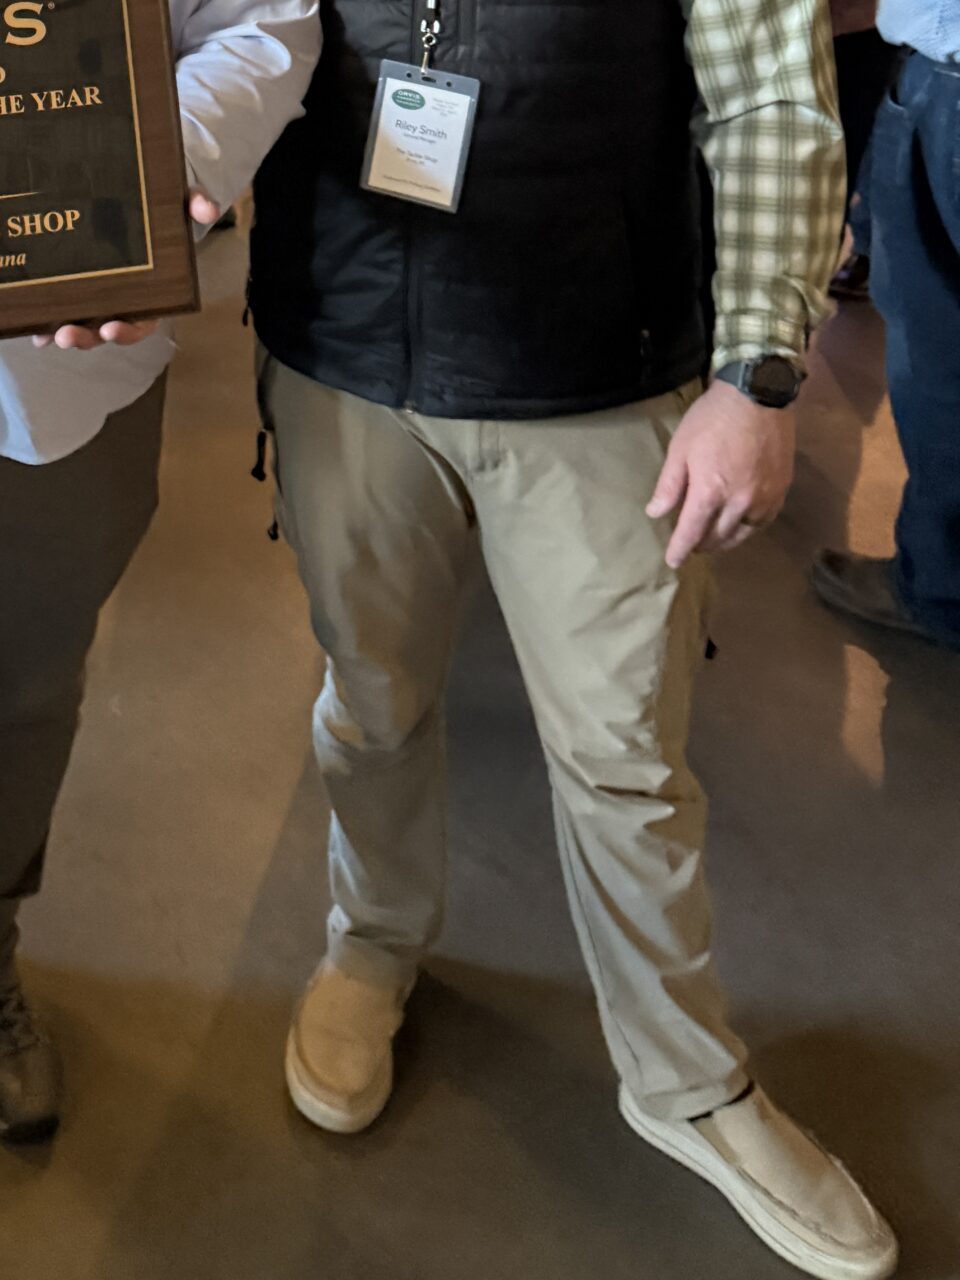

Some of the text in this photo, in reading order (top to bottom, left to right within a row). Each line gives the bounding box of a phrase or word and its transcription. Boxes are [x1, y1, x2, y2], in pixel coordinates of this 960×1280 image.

[31, 86, 103, 111] YEAR
[395, 119, 418, 134] Riley
[419, 124, 448, 139] Smith
[7, 209, 81, 237] SHOP
